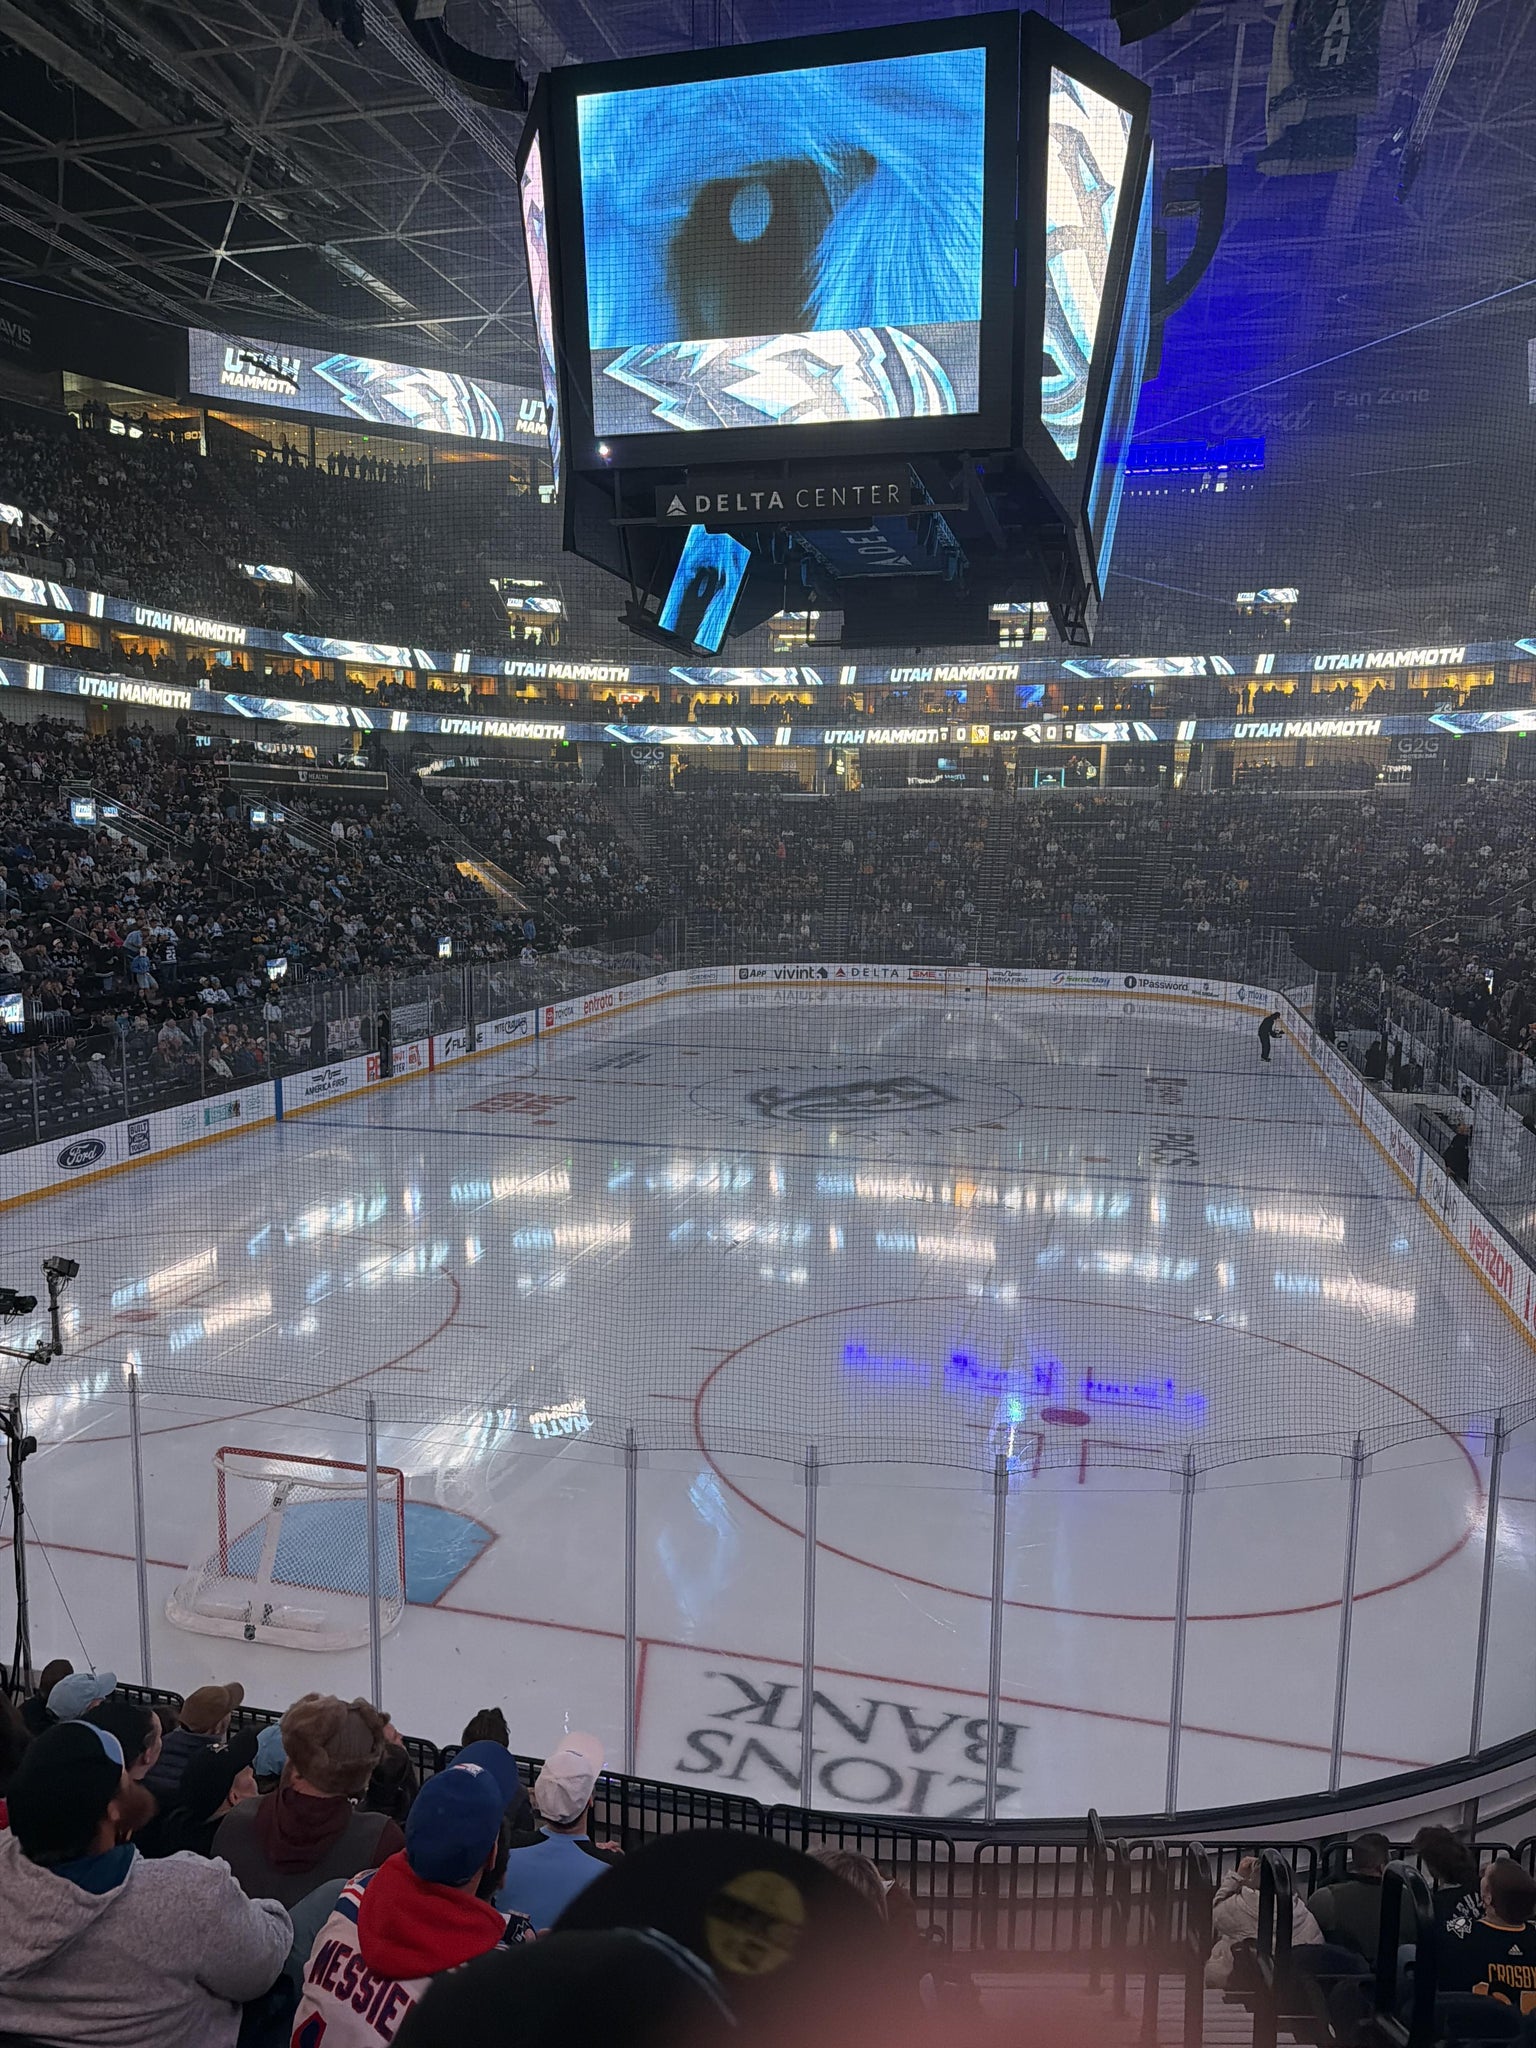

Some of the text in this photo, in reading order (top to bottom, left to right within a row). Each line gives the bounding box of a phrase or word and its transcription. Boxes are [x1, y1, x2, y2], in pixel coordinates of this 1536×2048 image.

[1320, 0, 1350, 67] AH
[221, 370, 298, 395] MAMMOTH
[1377, 387, 1431, 405] Zone
[695, 484, 901, 514] DELTA CENTER
[135, 606, 246, 645] UTAH MAMMOTH
[1313, 647, 1466, 671] UTAH MAMMOTH
[504, 660, 630, 682] UTAH MAMMOTH
[890, 665, 1020, 683] UTAH MAMMOTH
[78, 675, 192, 710] UTAH MAMMOTH
[440, 718, 566, 740] UTAH MAMMOTH
[824, 730, 865, 744] UTAH
[956, 727, 966, 742] 0
[993, 730, 1018, 742] 6:07
[1047, 726, 1056, 739] 0
[1233, 720, 1381, 739] UTAH MAMMOTH
[630, 745, 665, 759] G2G
[1397, 737, 1440, 753] G2G
[851, 968, 899, 978] DELTA
[1139, 978, 1189, 991] 1Password
[584, 993, 614, 1014] entrata
[305, 1080, 331, 1096] AMERICA
[331, 1077, 349, 1088] FIRST
[130, 1121, 148, 1136] BUILT
[66, 1143, 102, 1166] Ford
[131, 1141, 149, 1153] TOUGH
[1469, 1219, 1514, 1300] verizon
[708, 1671, 1031, 1773] BANK
[675, 1729, 1022, 1818] ZIONS
[308, 1938, 418, 2043] MESSIE
